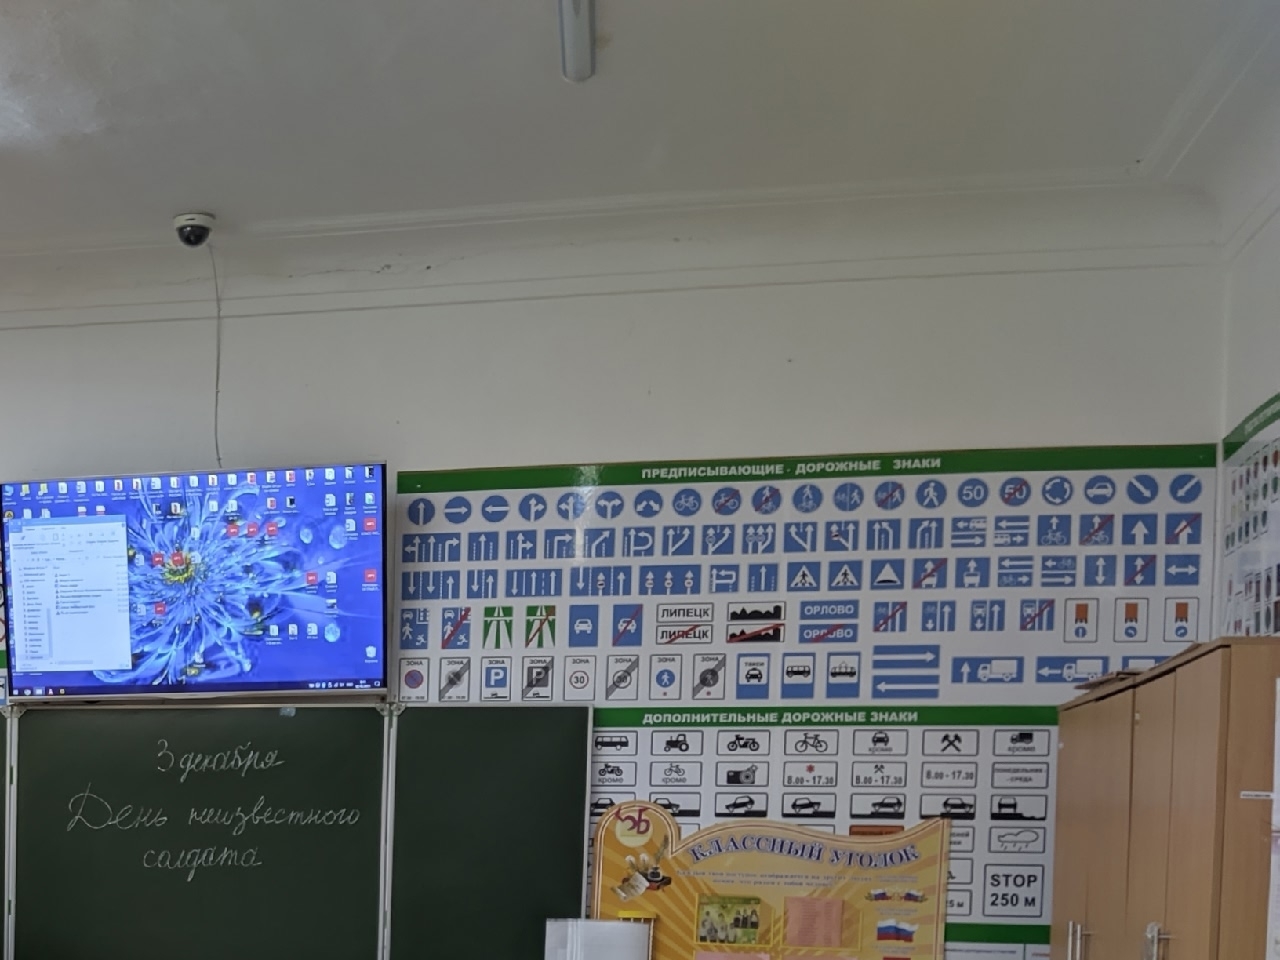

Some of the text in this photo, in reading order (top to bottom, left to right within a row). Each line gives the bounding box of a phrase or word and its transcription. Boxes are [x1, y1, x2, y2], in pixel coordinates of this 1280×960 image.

[641, 458, 941, 479] ПРЕДПИСЫВАЮЩИЕ ДОРОЖНЫЕ ЗНАКИ
[962, 485, 985, 499] 50
[661, 607, 710, 619] ЛИПЕЦК
[804, 604, 854, 616] ОРЛОВО
[660, 629, 709, 640] ЛИПЕЦК
[642, 711, 918, 725] ДОПОЛНИТЕЛЬНЫЕ ДОРОЖНЫЕ ЗНАКИ
[157, 738, 286, 783] 3 декабря
[67, 782, 361, 836] День неизвестного
[689, 834, 919, 868] КЛАССНЫЙ УГОЛОК
[143, 845, 262, 882] солдата
[990, 874, 1038, 888] STOP
[990, 893, 1019, 907] 250
